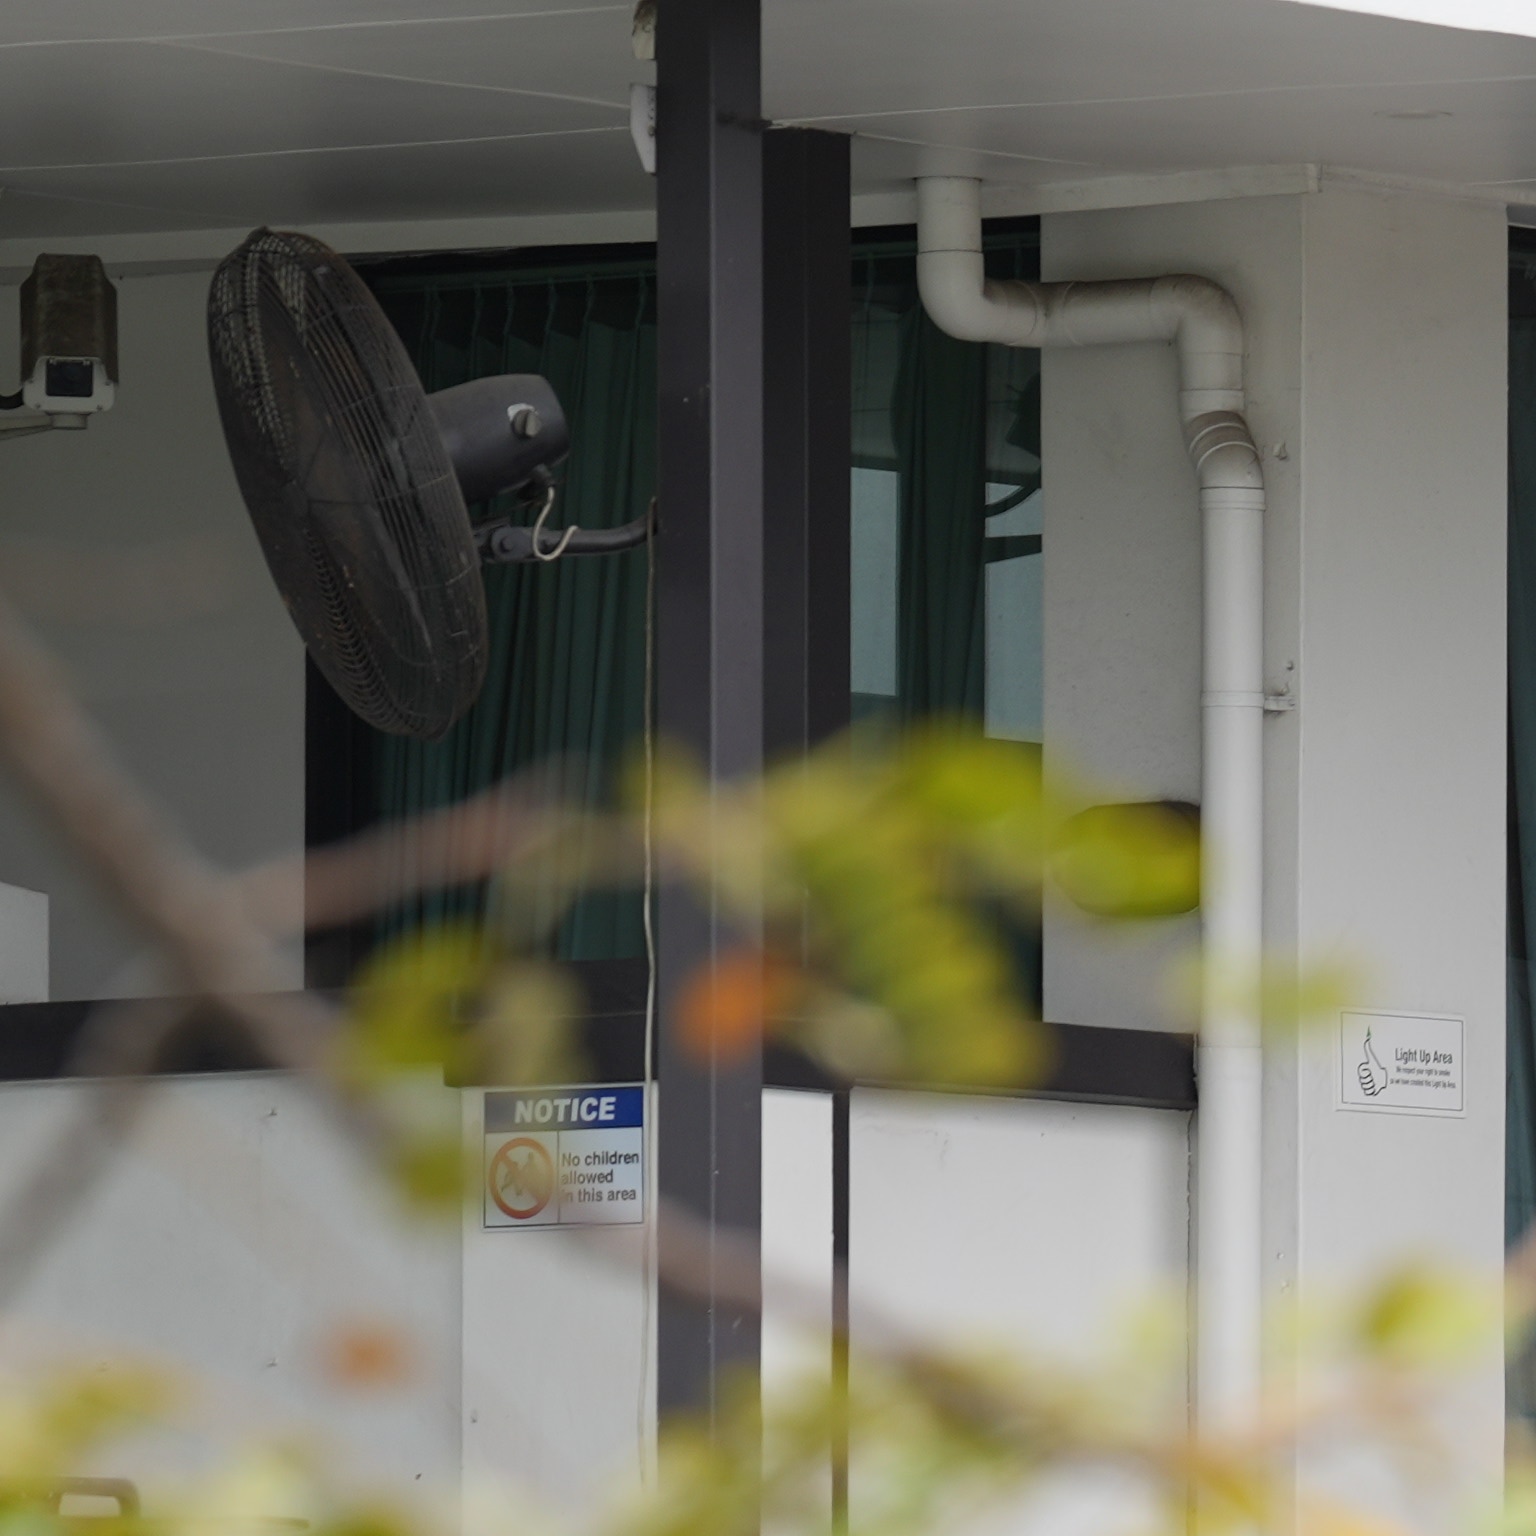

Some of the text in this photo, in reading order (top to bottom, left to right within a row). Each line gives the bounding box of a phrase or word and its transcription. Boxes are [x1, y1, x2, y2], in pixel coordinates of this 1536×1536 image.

[1395, 1048, 1453, 1065] Light Up Area
[514, 1096, 617, 1123] NOTICE
[561, 1151, 639, 1166] No children
[561, 1169, 613, 1185] allowed
[560, 1188, 636, 1203] in this area
